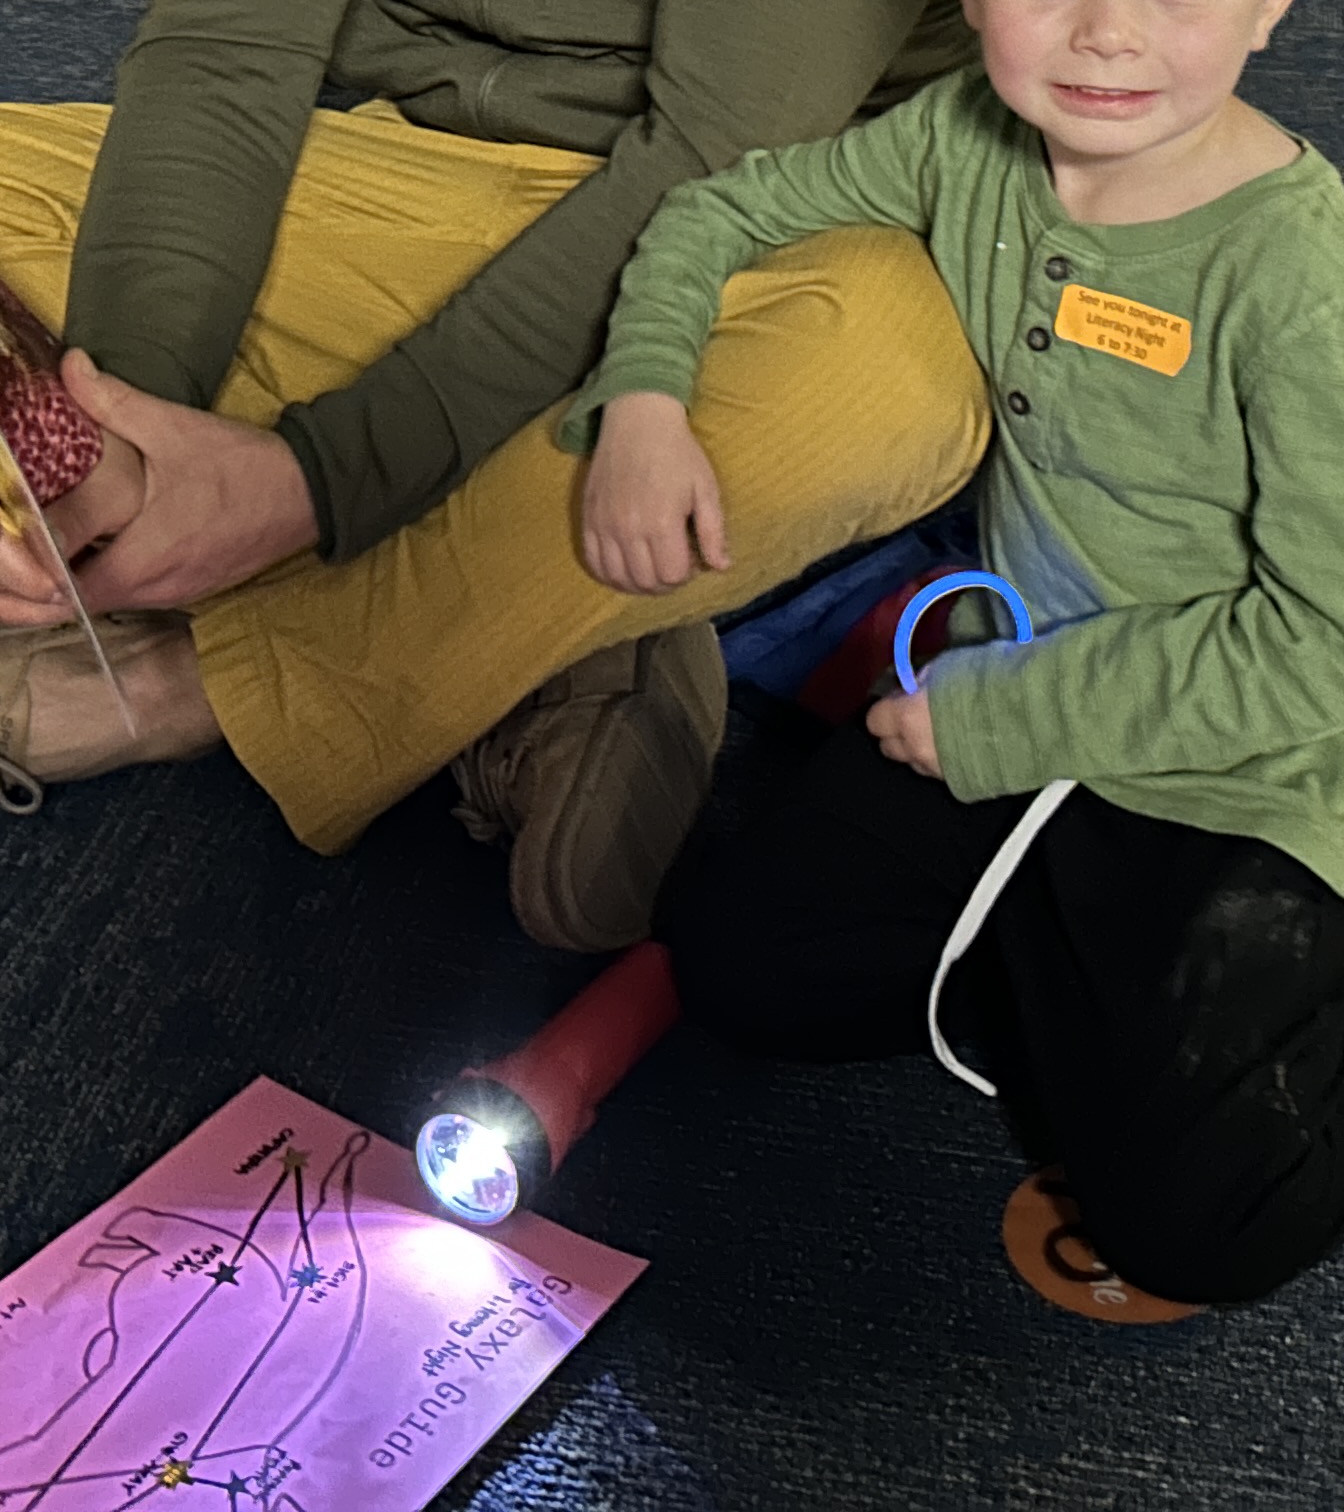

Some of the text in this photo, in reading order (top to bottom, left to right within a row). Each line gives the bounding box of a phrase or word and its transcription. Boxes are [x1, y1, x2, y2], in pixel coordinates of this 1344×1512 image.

[1078, 291, 1182, 334] See you tonight at
[1086, 312, 1166, 348] Literacy Night
[1096, 334, 1148, 360] 6 to 7:30
[368, 1274, 573, 1469] Galaxy Guide
